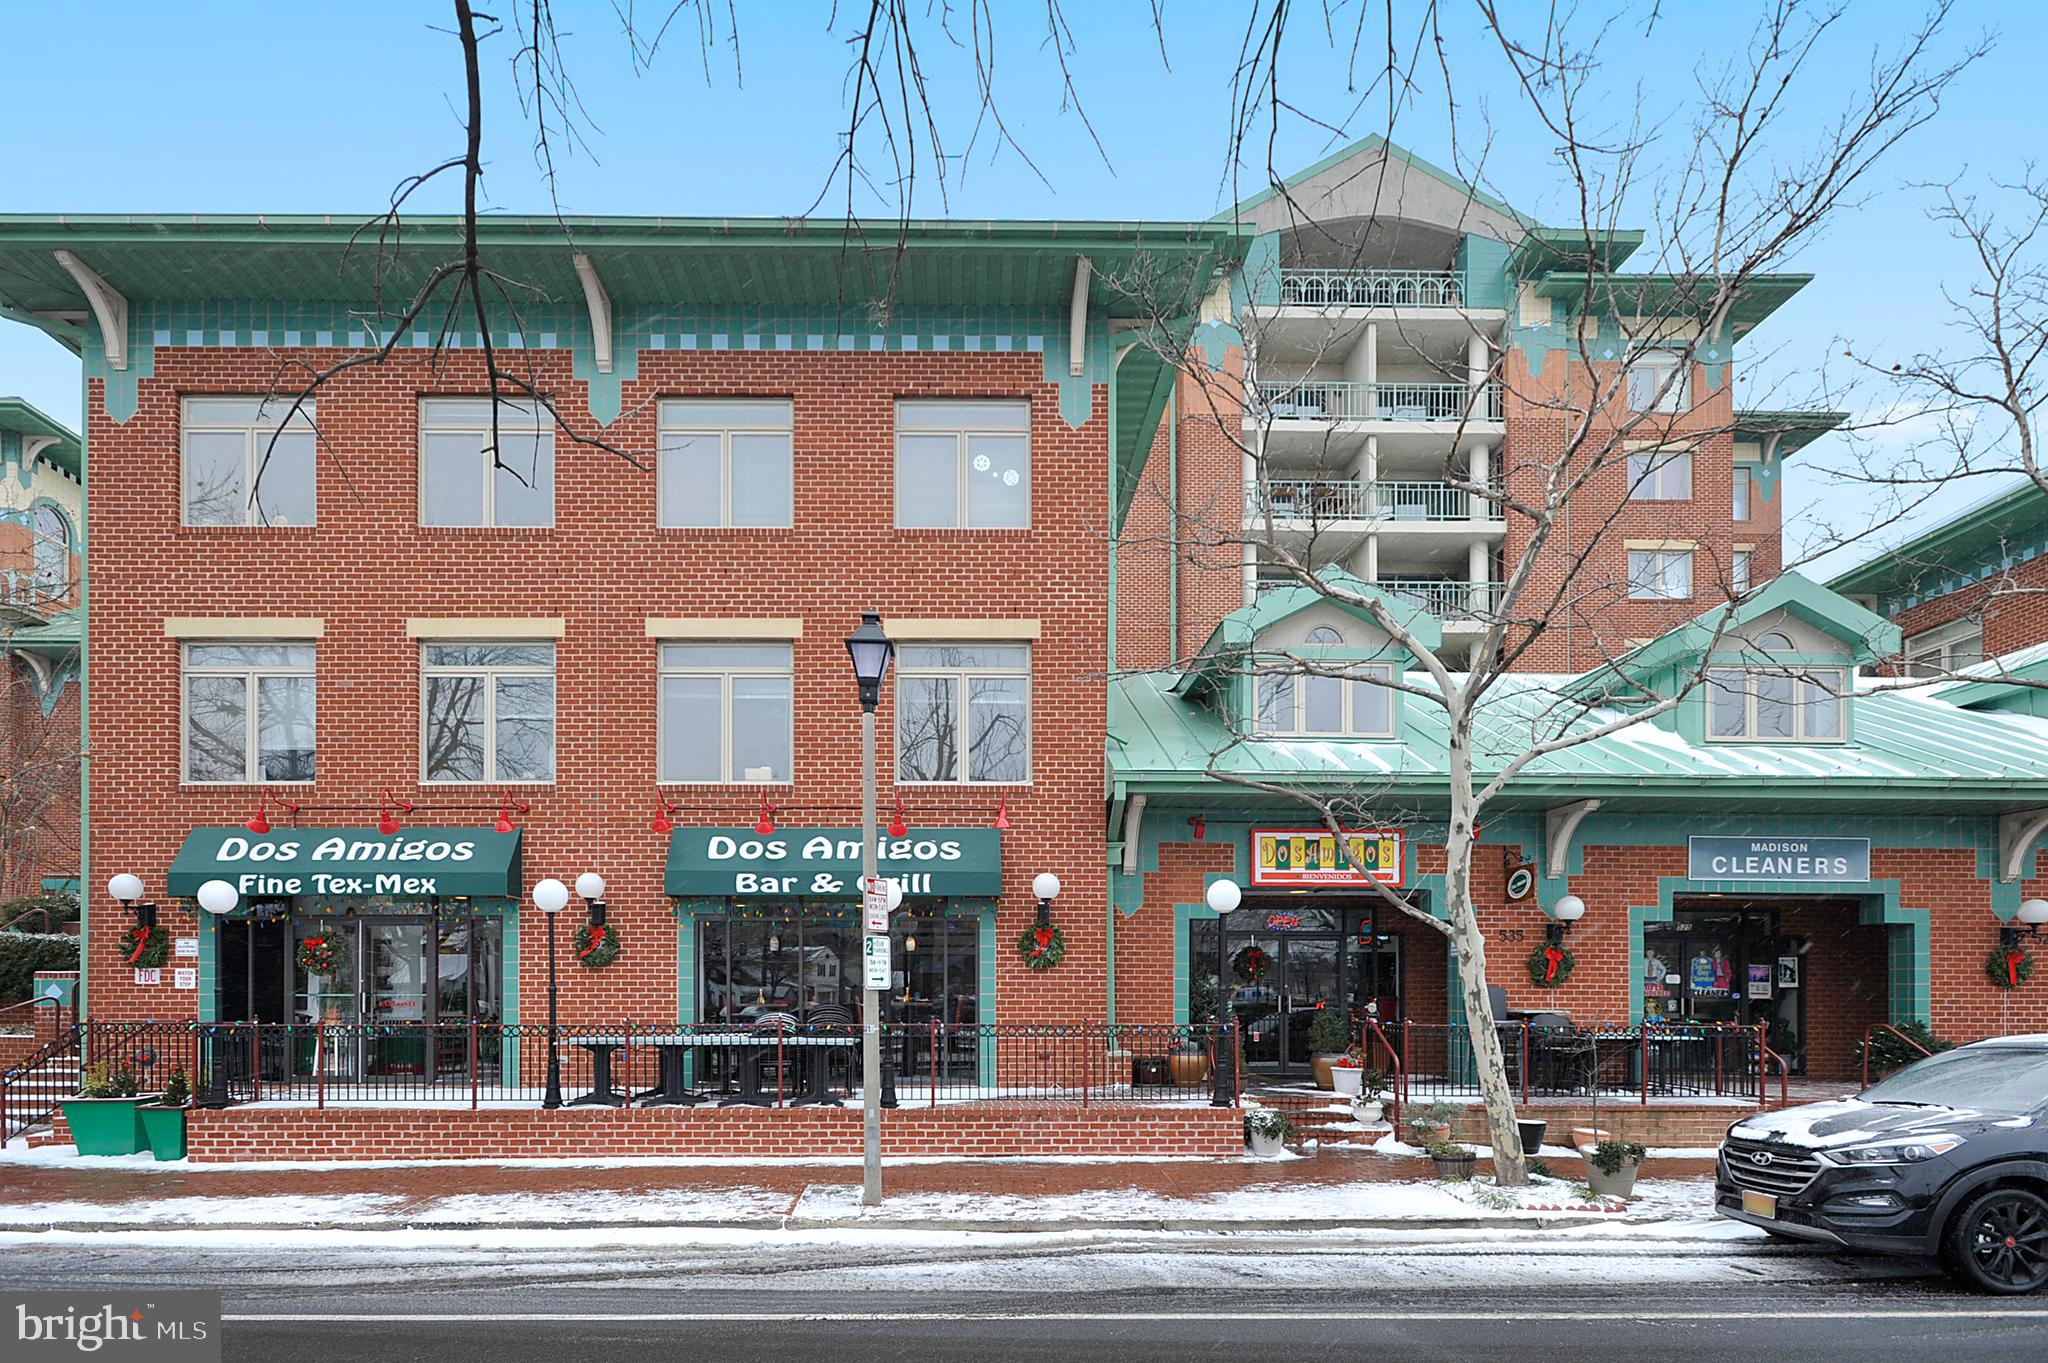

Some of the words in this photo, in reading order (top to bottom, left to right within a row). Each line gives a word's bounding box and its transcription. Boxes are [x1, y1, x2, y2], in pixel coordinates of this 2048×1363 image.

[215, 837, 300, 861] Dos
[311, 837, 475, 861] Amigos
[707, 836, 788, 860] Dos
[802, 836, 962, 861] Amigos
[1751, 842, 1808, 852] MADISON
[1711, 856, 1848, 875] CLEANERS
[239, 874, 302, 894] Fine
[311, 874, 437, 894] Tex-Mex
[735, 873, 798, 893] Bar
[810, 872, 844, 893] &
[856, 873, 931, 894] ill
[1267, 914, 1299, 928] OPEN
[1499, 929, 1524, 942] 535
[866, 941, 873, 953] 2
[138, 969, 156, 983] FDC
